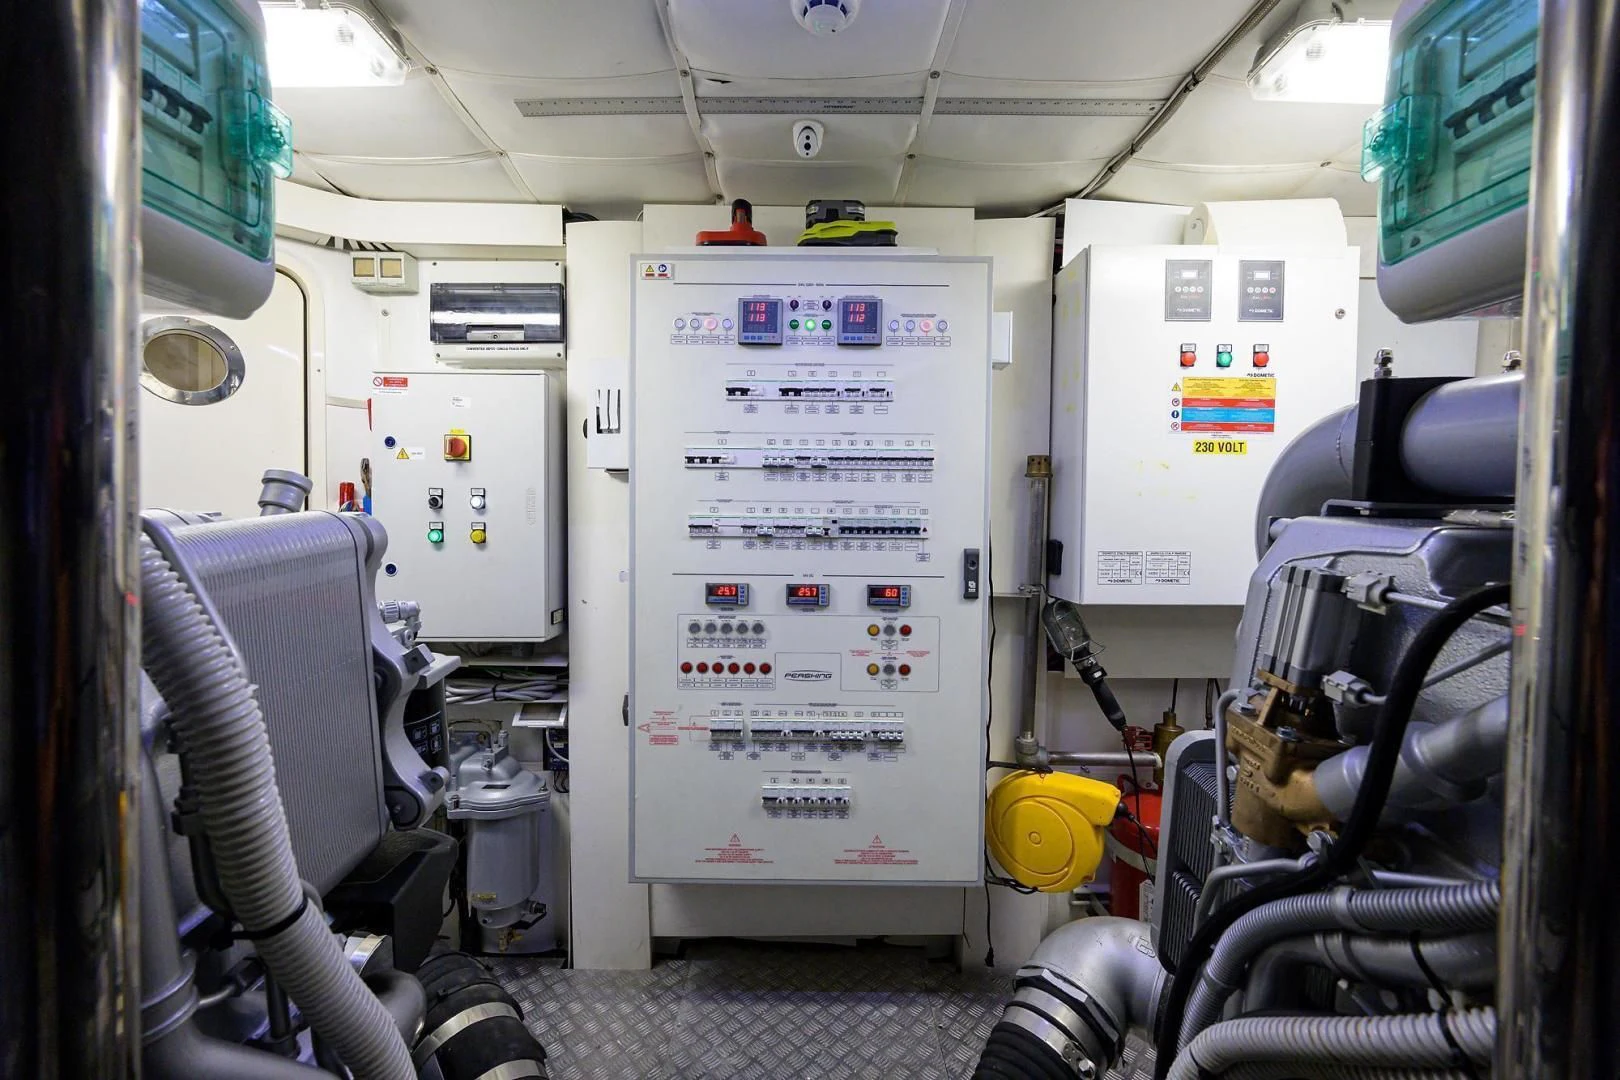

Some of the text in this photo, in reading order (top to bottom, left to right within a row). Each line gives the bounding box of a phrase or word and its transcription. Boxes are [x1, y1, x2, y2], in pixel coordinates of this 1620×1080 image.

[750, 302, 766, 311] 113
[850, 303, 865, 311] 113
[750, 313, 766, 322] 113
[850, 313, 865, 322] 112
[1195, 442, 1245, 453] 230 VOLT
[885, 588, 898, 597] 60
